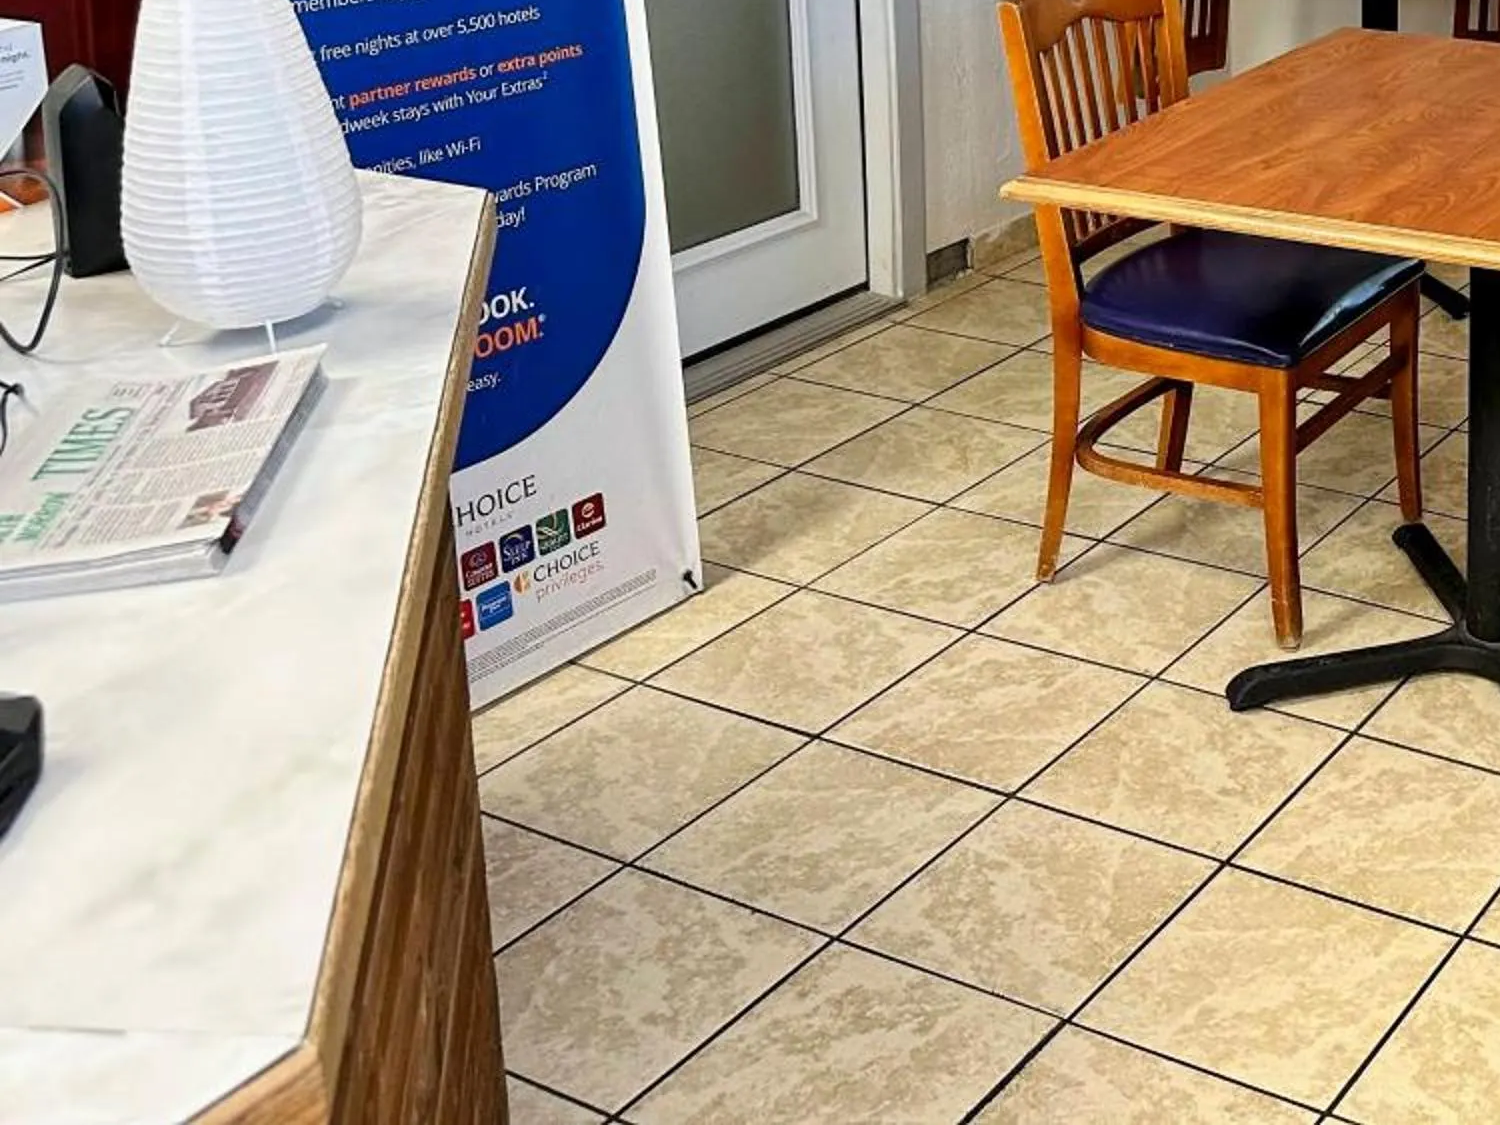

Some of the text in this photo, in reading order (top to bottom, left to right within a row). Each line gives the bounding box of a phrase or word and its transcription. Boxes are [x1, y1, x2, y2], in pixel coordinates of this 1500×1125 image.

[320, 4, 541, 62] free nights at over 5,500 hotels
[349, 81, 411, 111] partner
[414, 66, 477, 92] rewards
[479, 62, 495, 78] or
[497, 54, 536, 73] extra
[539, 43, 584, 68] points
[340, 109, 390, 134] dweek
[392, 103, 430, 122] stays
[432, 93, 464, 114] with
[465, 85, 499, 105] Your
[419, 148, 445, 165] like
[445, 136, 481, 159] Wi-Fi
[534, 164, 597, 191] Program
[496, 206, 526, 228] day!
[466, 373, 501, 392] easy.
[31, 406, 136, 482] TIMES
[455, 474, 537, 527] HOICE
[533, 540, 601, 582] CHOICE
[535, 560, 605, 603] privileges
